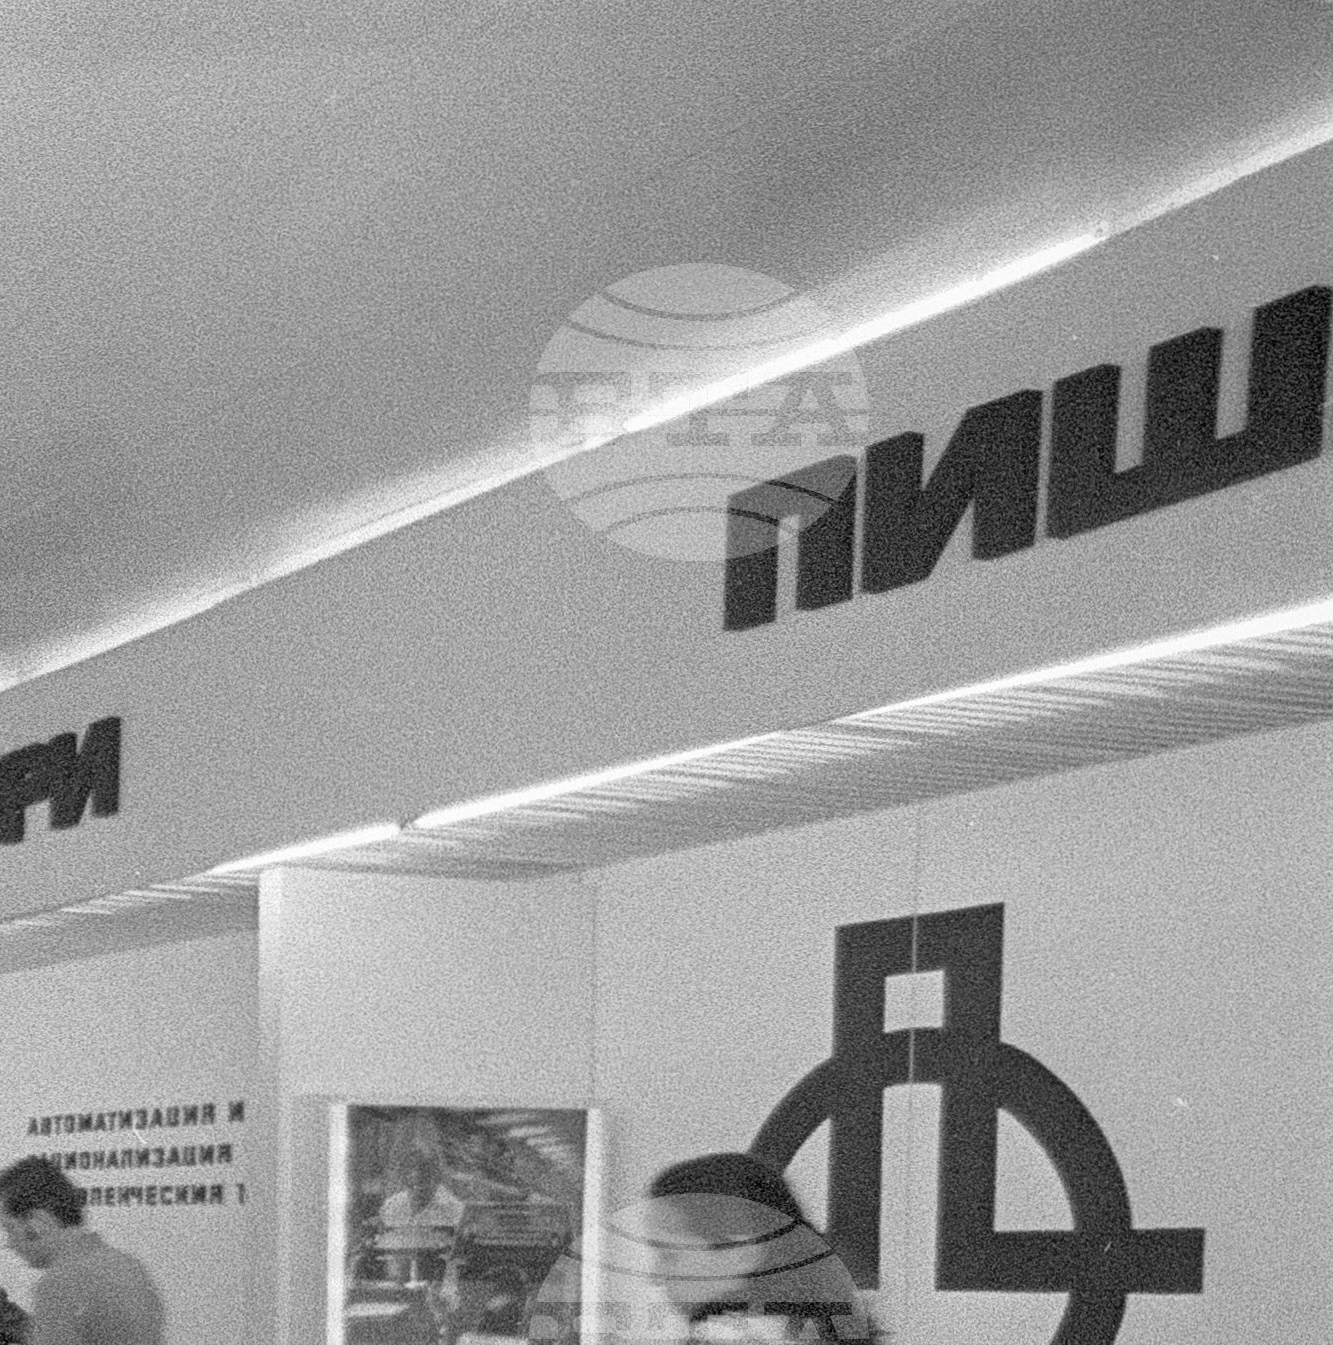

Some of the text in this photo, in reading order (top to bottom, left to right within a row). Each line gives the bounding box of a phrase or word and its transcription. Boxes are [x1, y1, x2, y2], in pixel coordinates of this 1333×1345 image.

[723, 284, 1332, 631] ПИШ
[26, 1099, 246, 1136] АВТОМАТИЗАЦИЯ И
